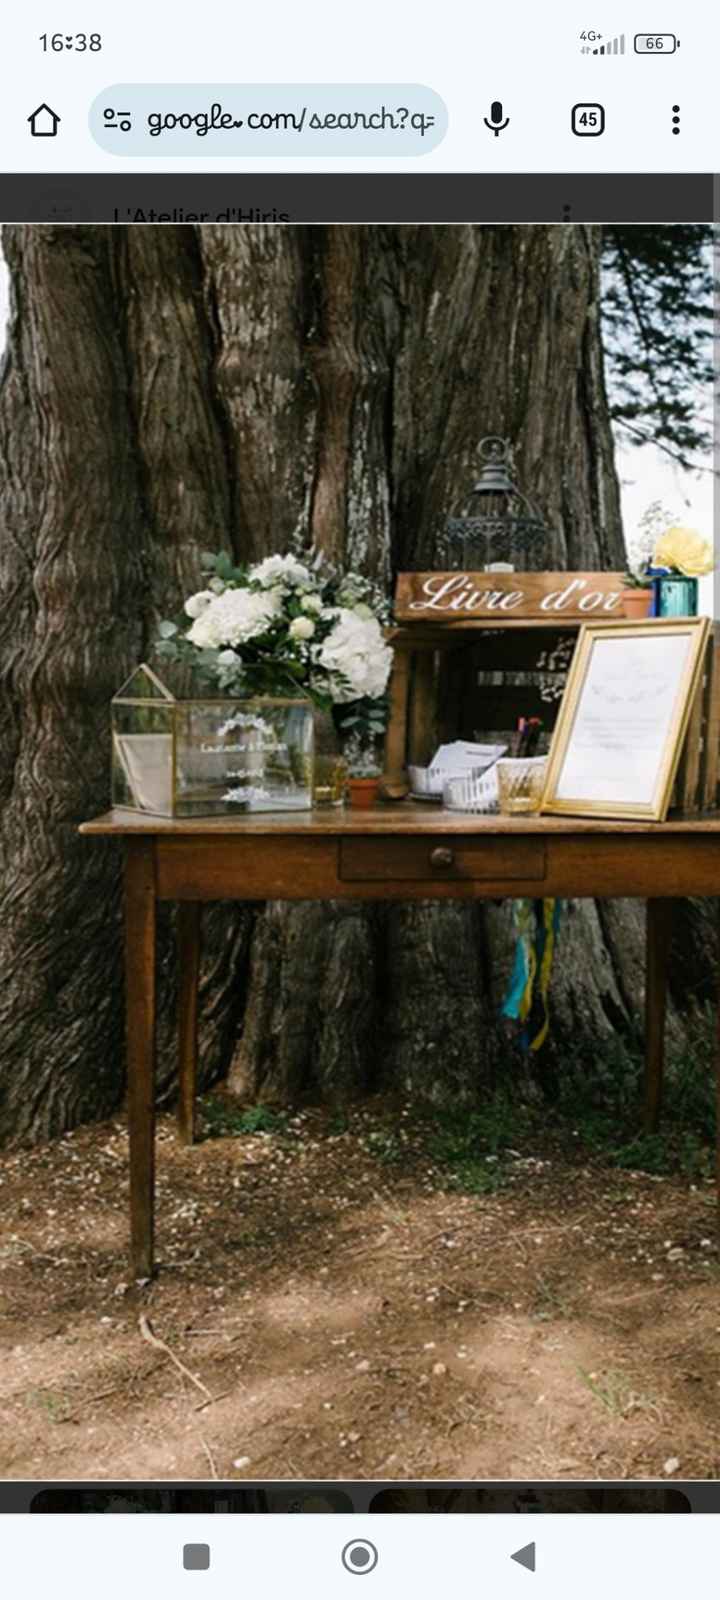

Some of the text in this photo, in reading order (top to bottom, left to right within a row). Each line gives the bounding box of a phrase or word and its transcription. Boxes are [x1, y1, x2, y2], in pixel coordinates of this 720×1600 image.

[39, 33, 102, 52] 16:38
[579, 30, 603, 42] 4G+
[646, 37, 664, 50] 66
[579, 112, 597, 127] 45
[113, 207, 291, 223] L'Atelier d'Hiris
[408, 575, 624, 611] Livre d'or
